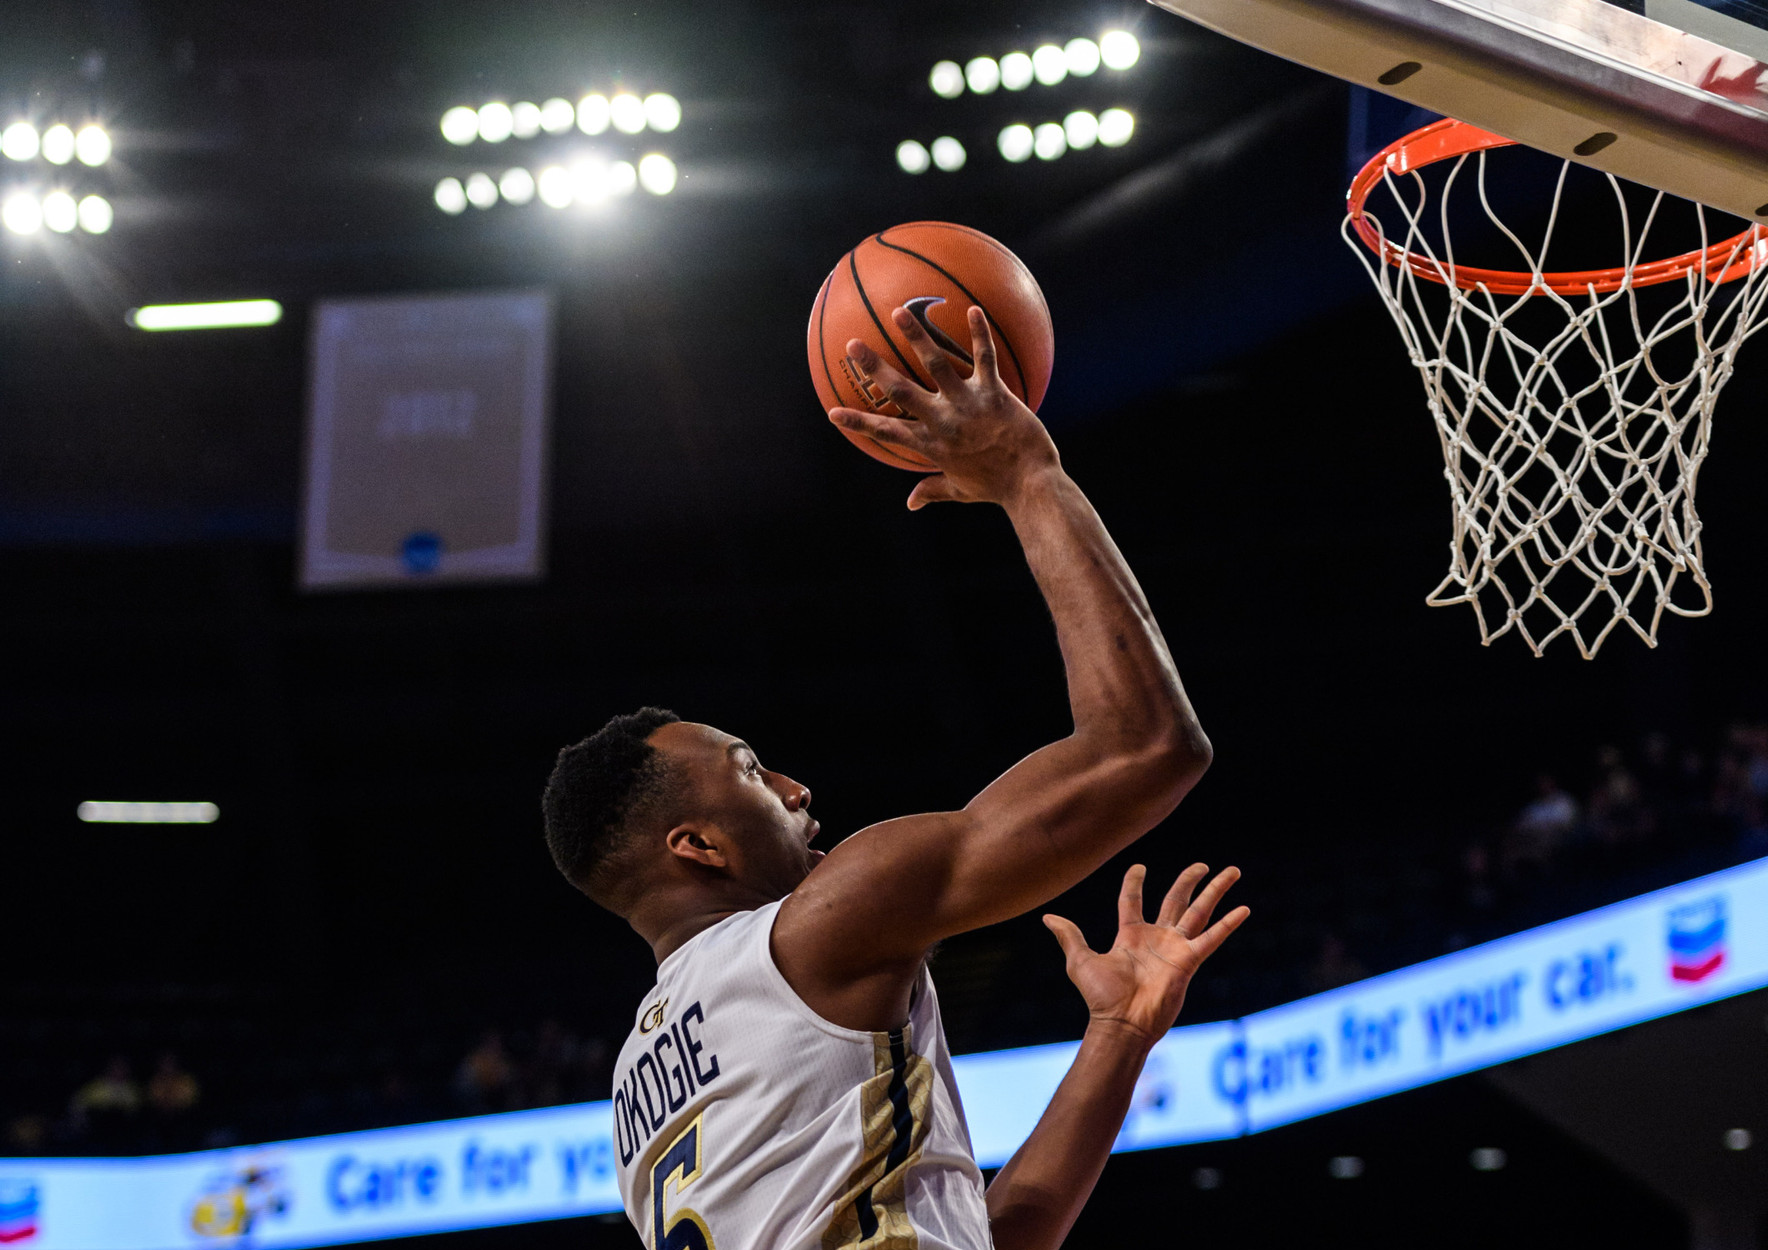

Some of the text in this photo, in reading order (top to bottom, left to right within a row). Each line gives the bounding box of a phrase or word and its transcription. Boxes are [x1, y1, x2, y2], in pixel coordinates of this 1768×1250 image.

[615, 1000, 721, 1168] OKOGIE
[1212, 946, 1635, 1103] Care for your car.
[326, 1154, 441, 1213] Care
[461, 1138, 537, 1196] for
